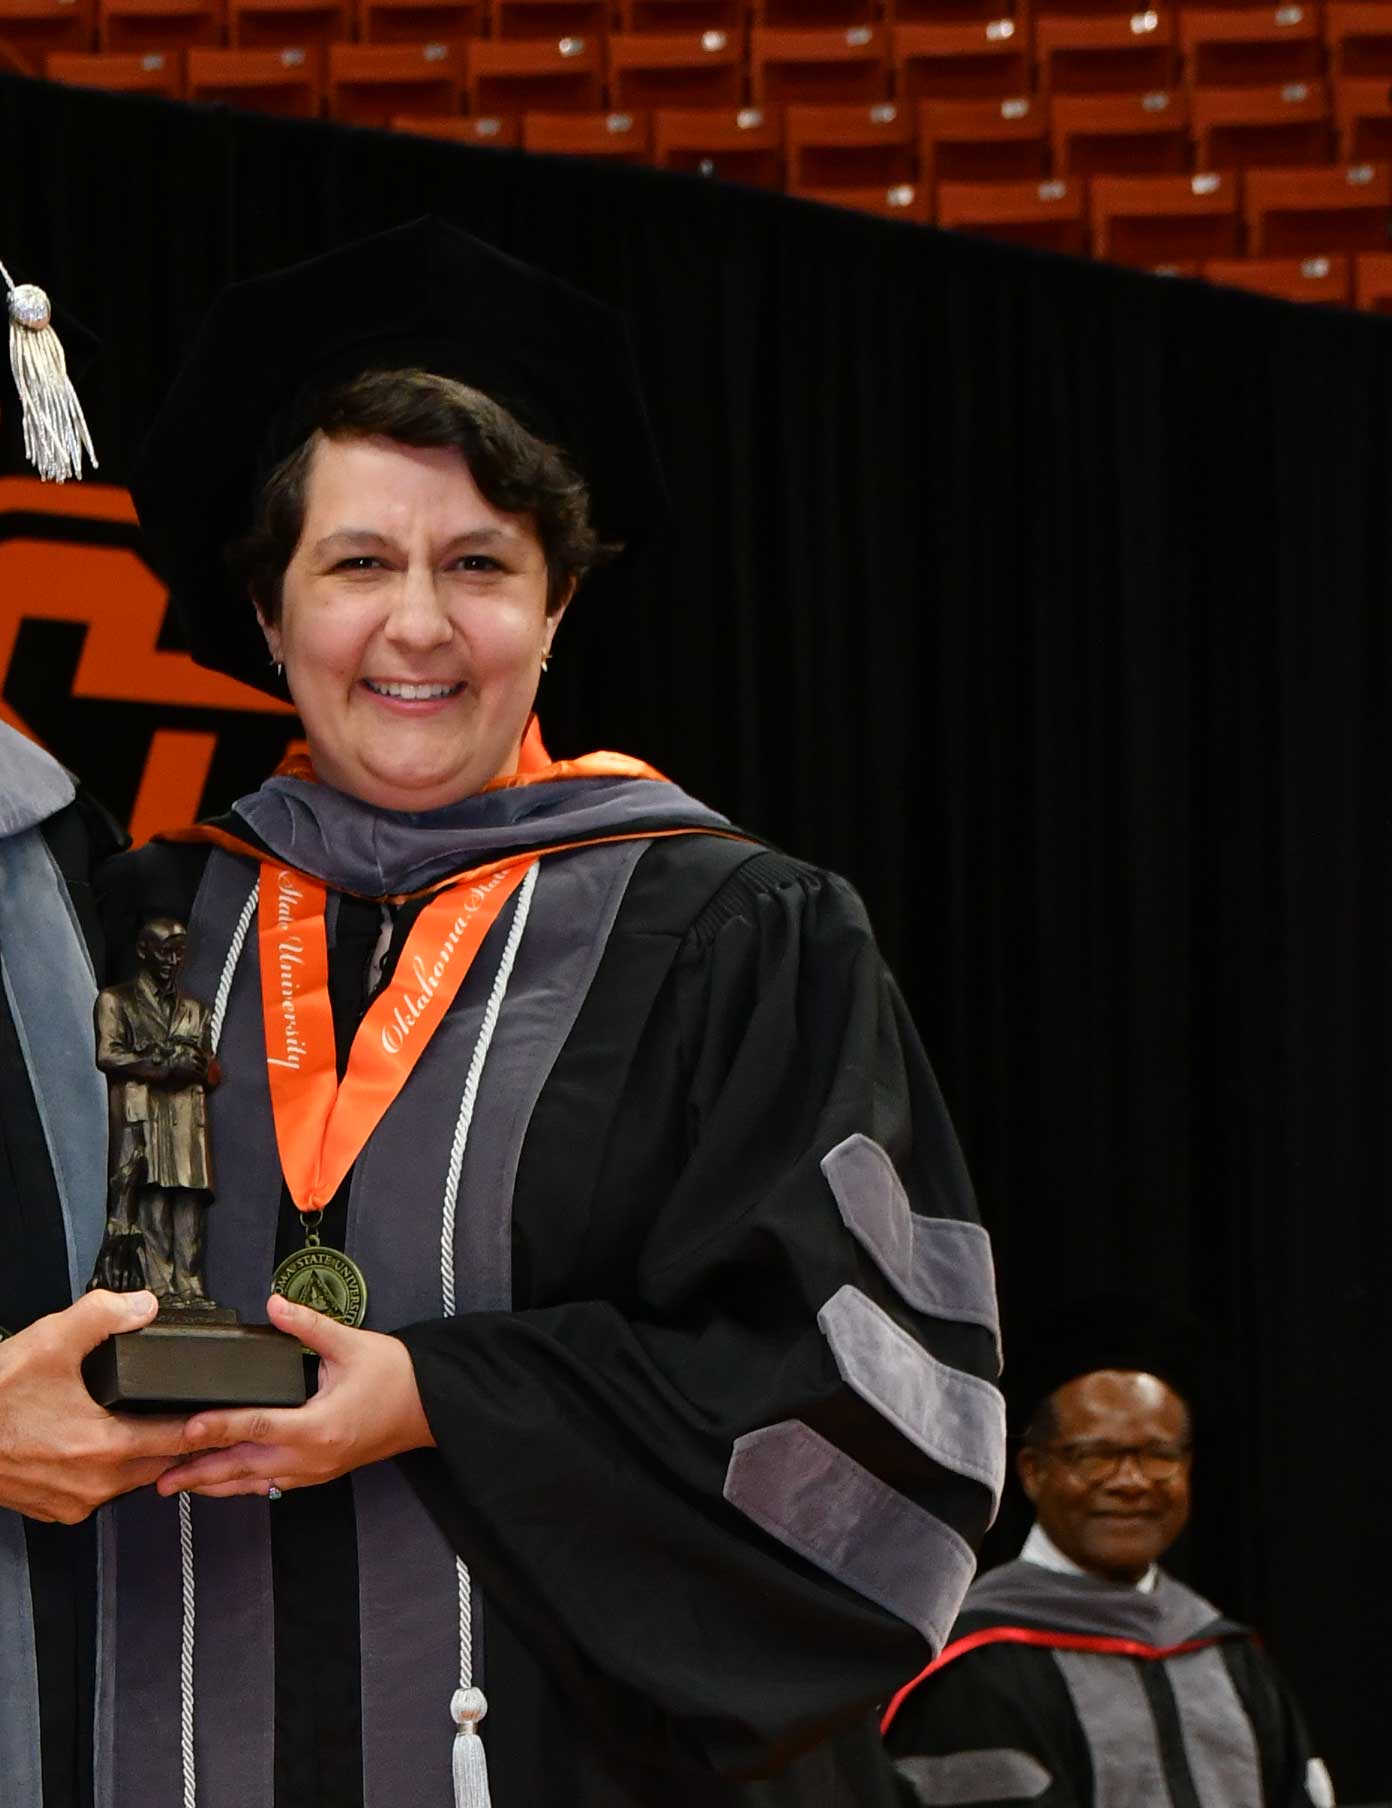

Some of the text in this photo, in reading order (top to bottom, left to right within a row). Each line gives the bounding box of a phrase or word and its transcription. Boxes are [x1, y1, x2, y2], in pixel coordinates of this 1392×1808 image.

[267, 935, 307, 1070] University
[381, 916, 469, 1054] Oklahoma
[296, 1253, 332, 1267] STATE
